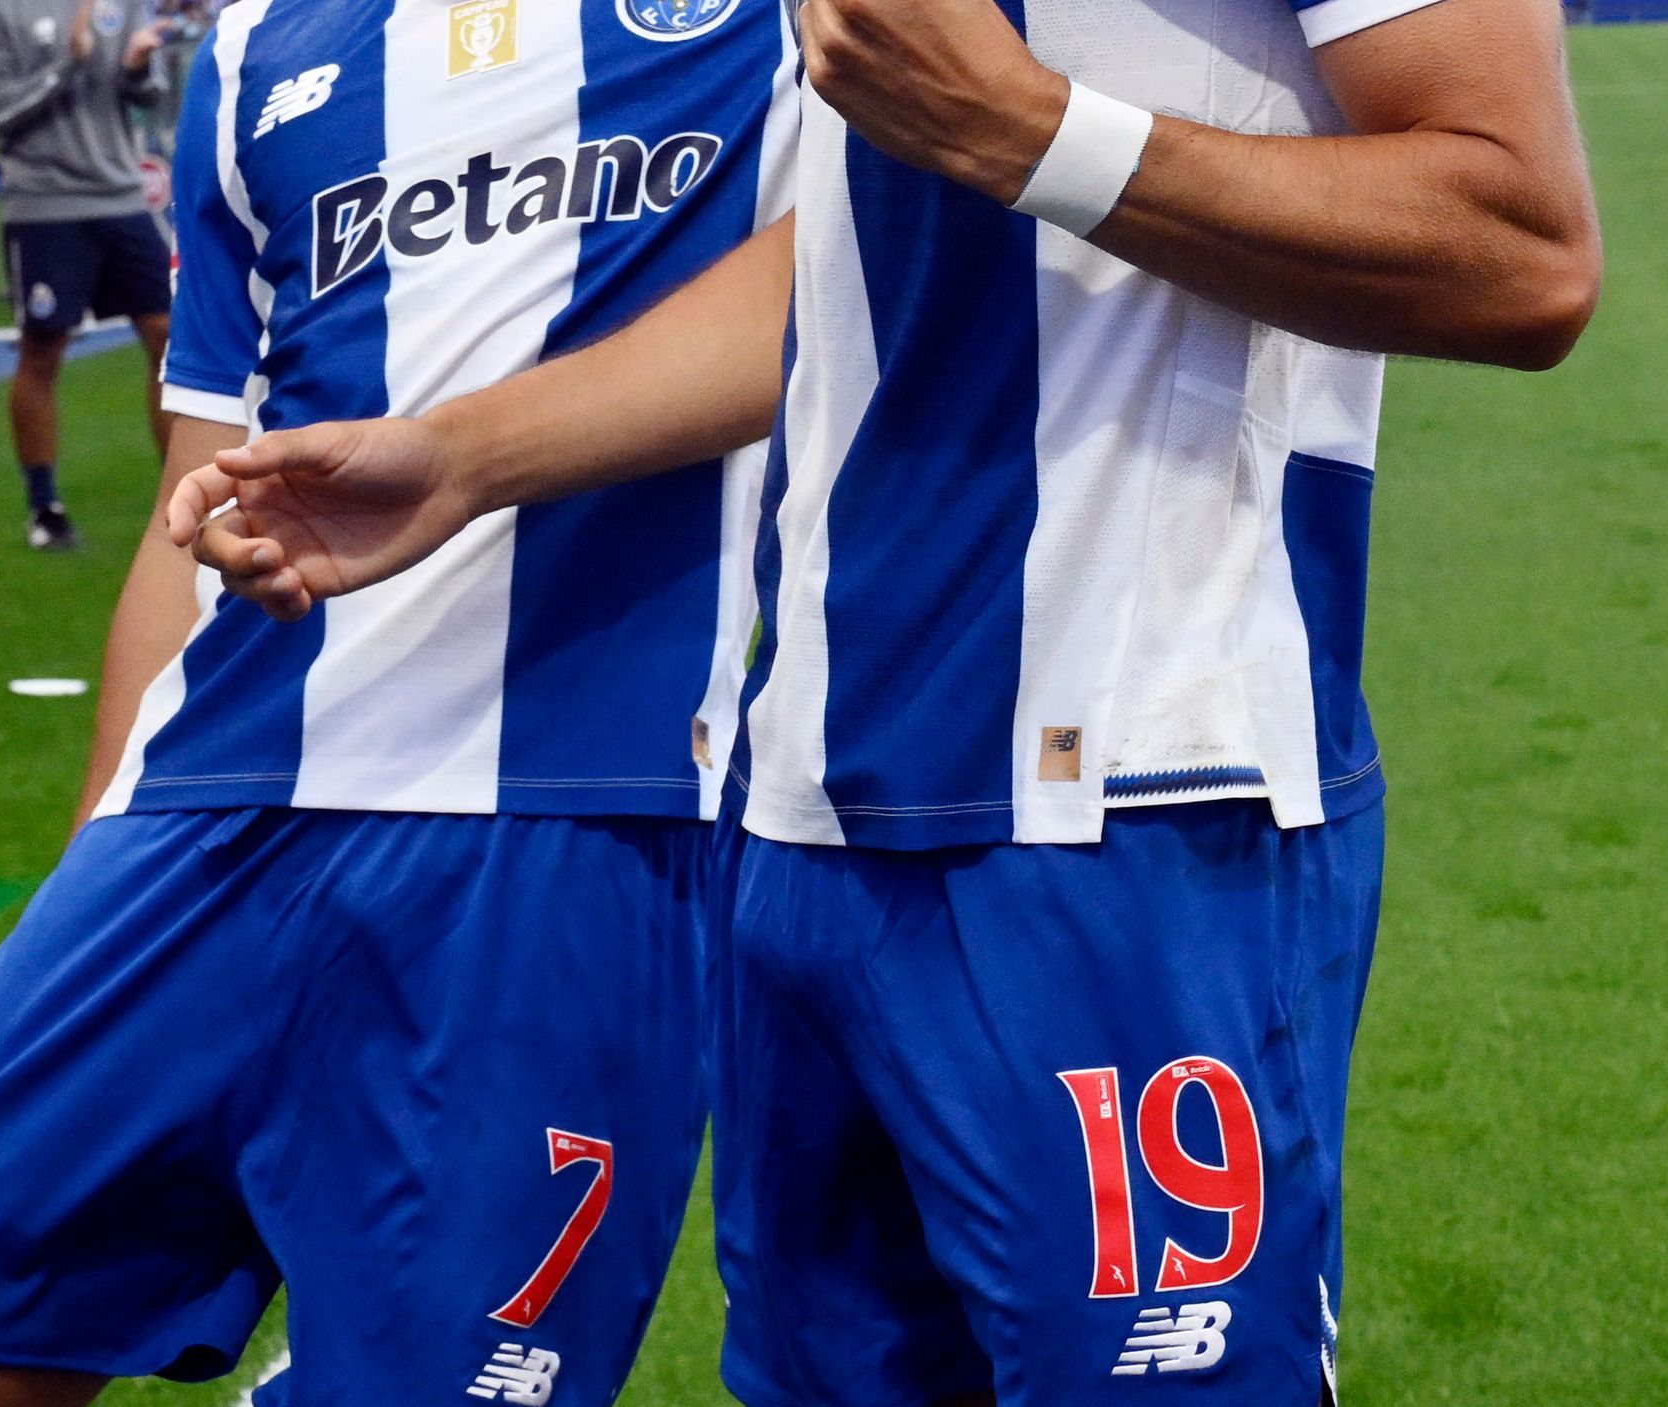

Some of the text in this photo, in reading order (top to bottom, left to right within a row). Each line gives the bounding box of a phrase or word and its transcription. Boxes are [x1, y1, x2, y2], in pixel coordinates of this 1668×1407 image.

[311, 132, 723, 299] Betano
[487, 1127, 612, 1328] 7
[1055, 1054, 1265, 1299] 19
